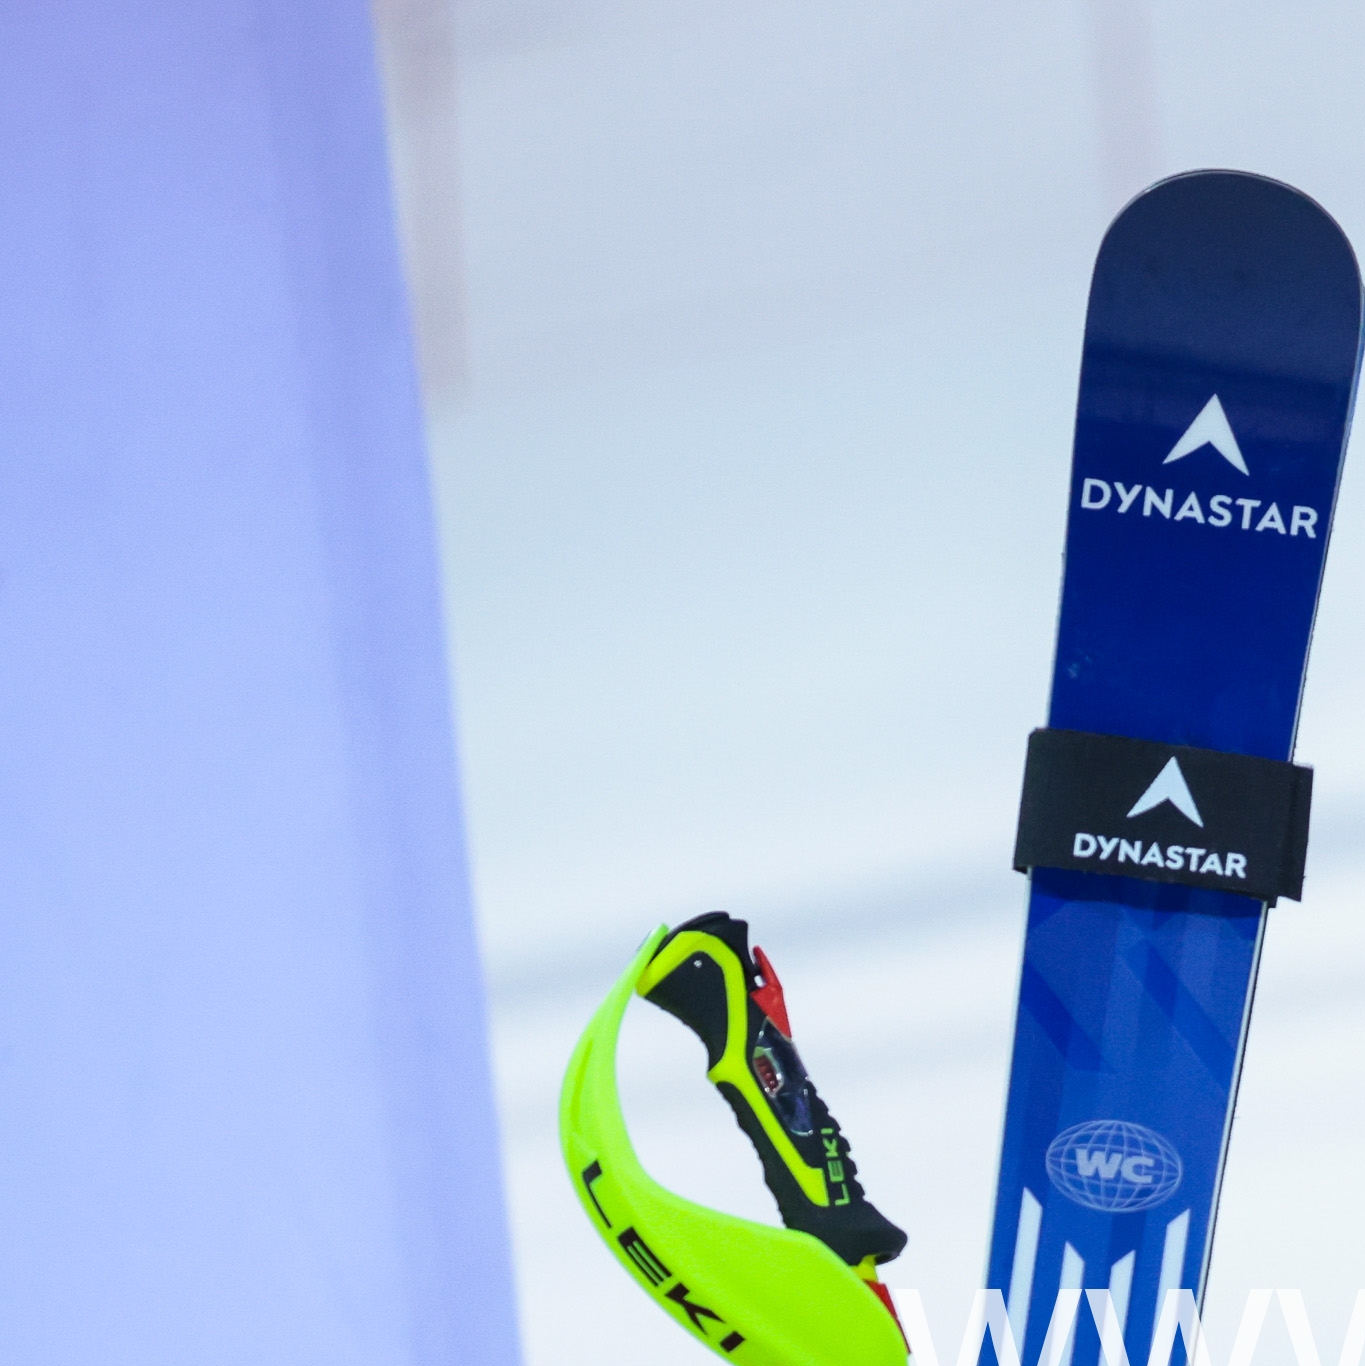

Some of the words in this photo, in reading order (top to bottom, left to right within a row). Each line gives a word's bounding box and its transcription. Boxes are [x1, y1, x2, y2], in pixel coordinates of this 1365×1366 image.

[1080, 478, 1318, 540] DYNASTAR
[1072, 831, 1248, 880] DYNASTAR
[821, 1127, 850, 1206] LEKI
[1075, 1148, 1156, 1184] WC
[582, 1160, 744, 1353] LEKI
